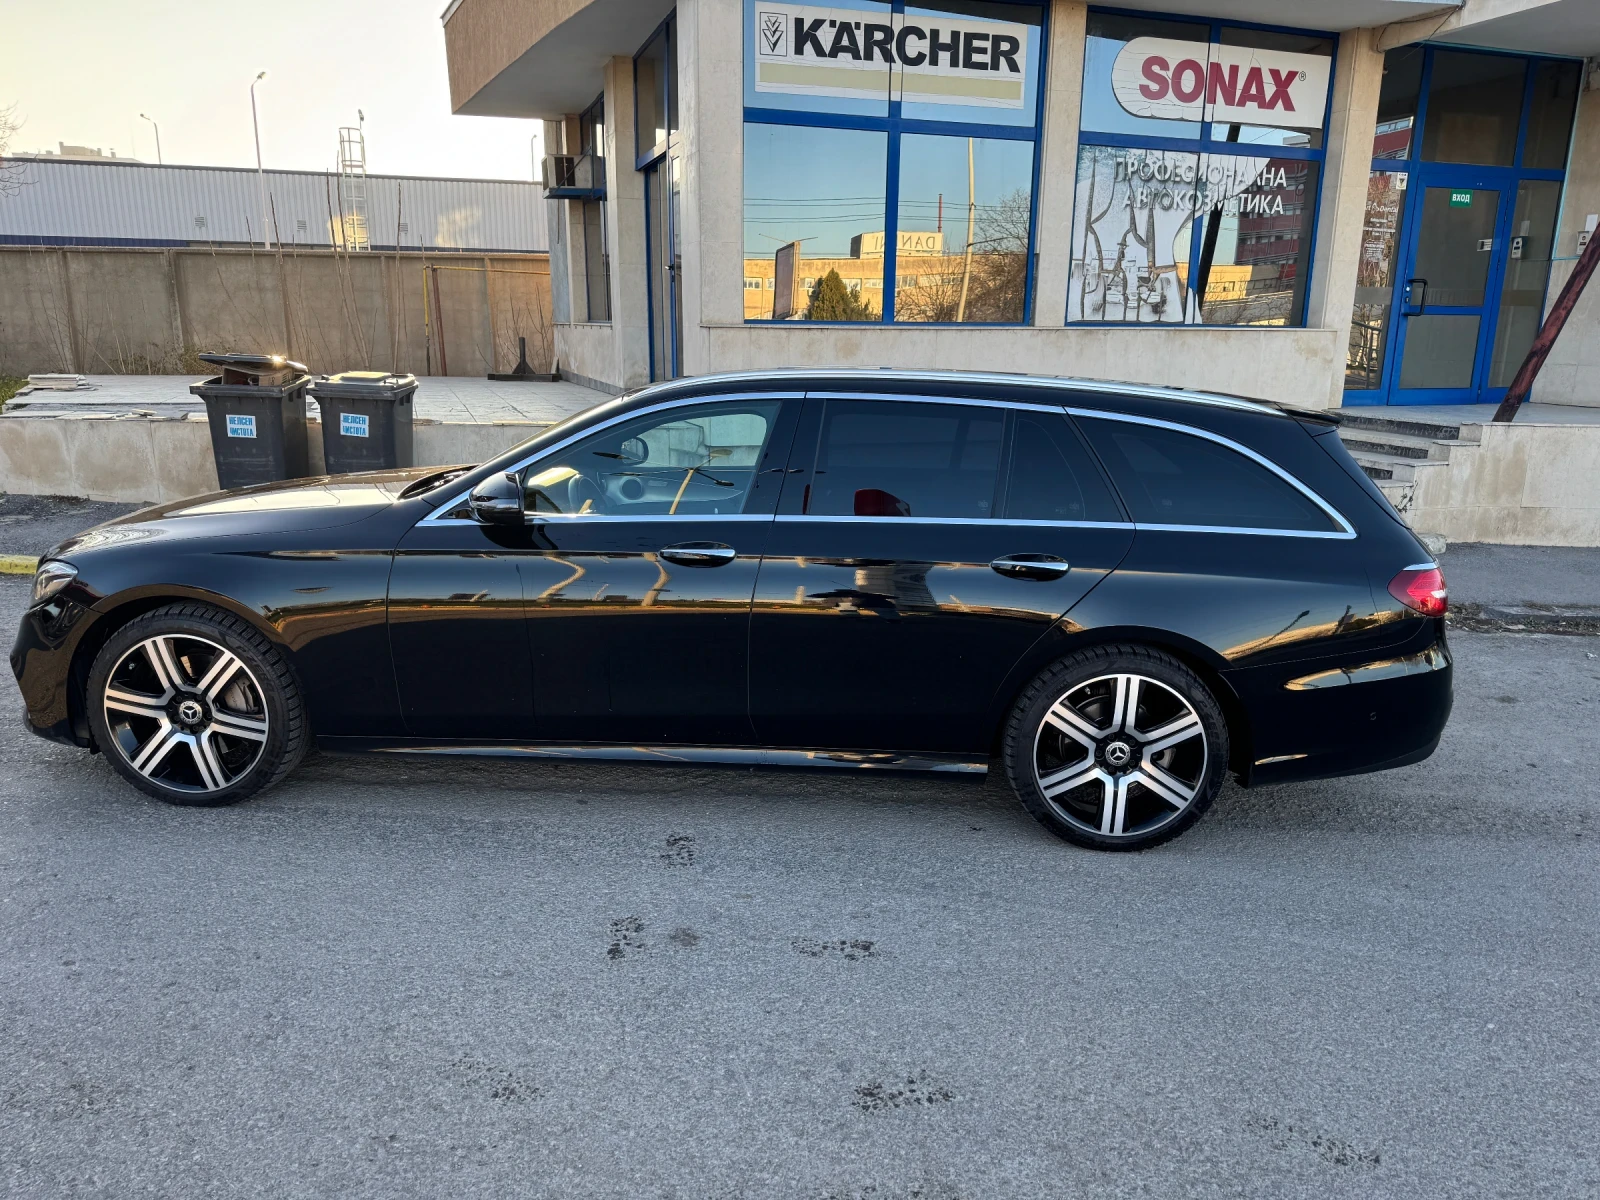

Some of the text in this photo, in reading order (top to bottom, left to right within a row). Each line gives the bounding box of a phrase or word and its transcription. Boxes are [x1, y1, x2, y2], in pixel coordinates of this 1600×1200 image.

[794, 17, 1021, 73] KÄRCHER
[1139, 55, 1299, 112] SONAX
[1452, 193, 1470, 204] ВХОД
